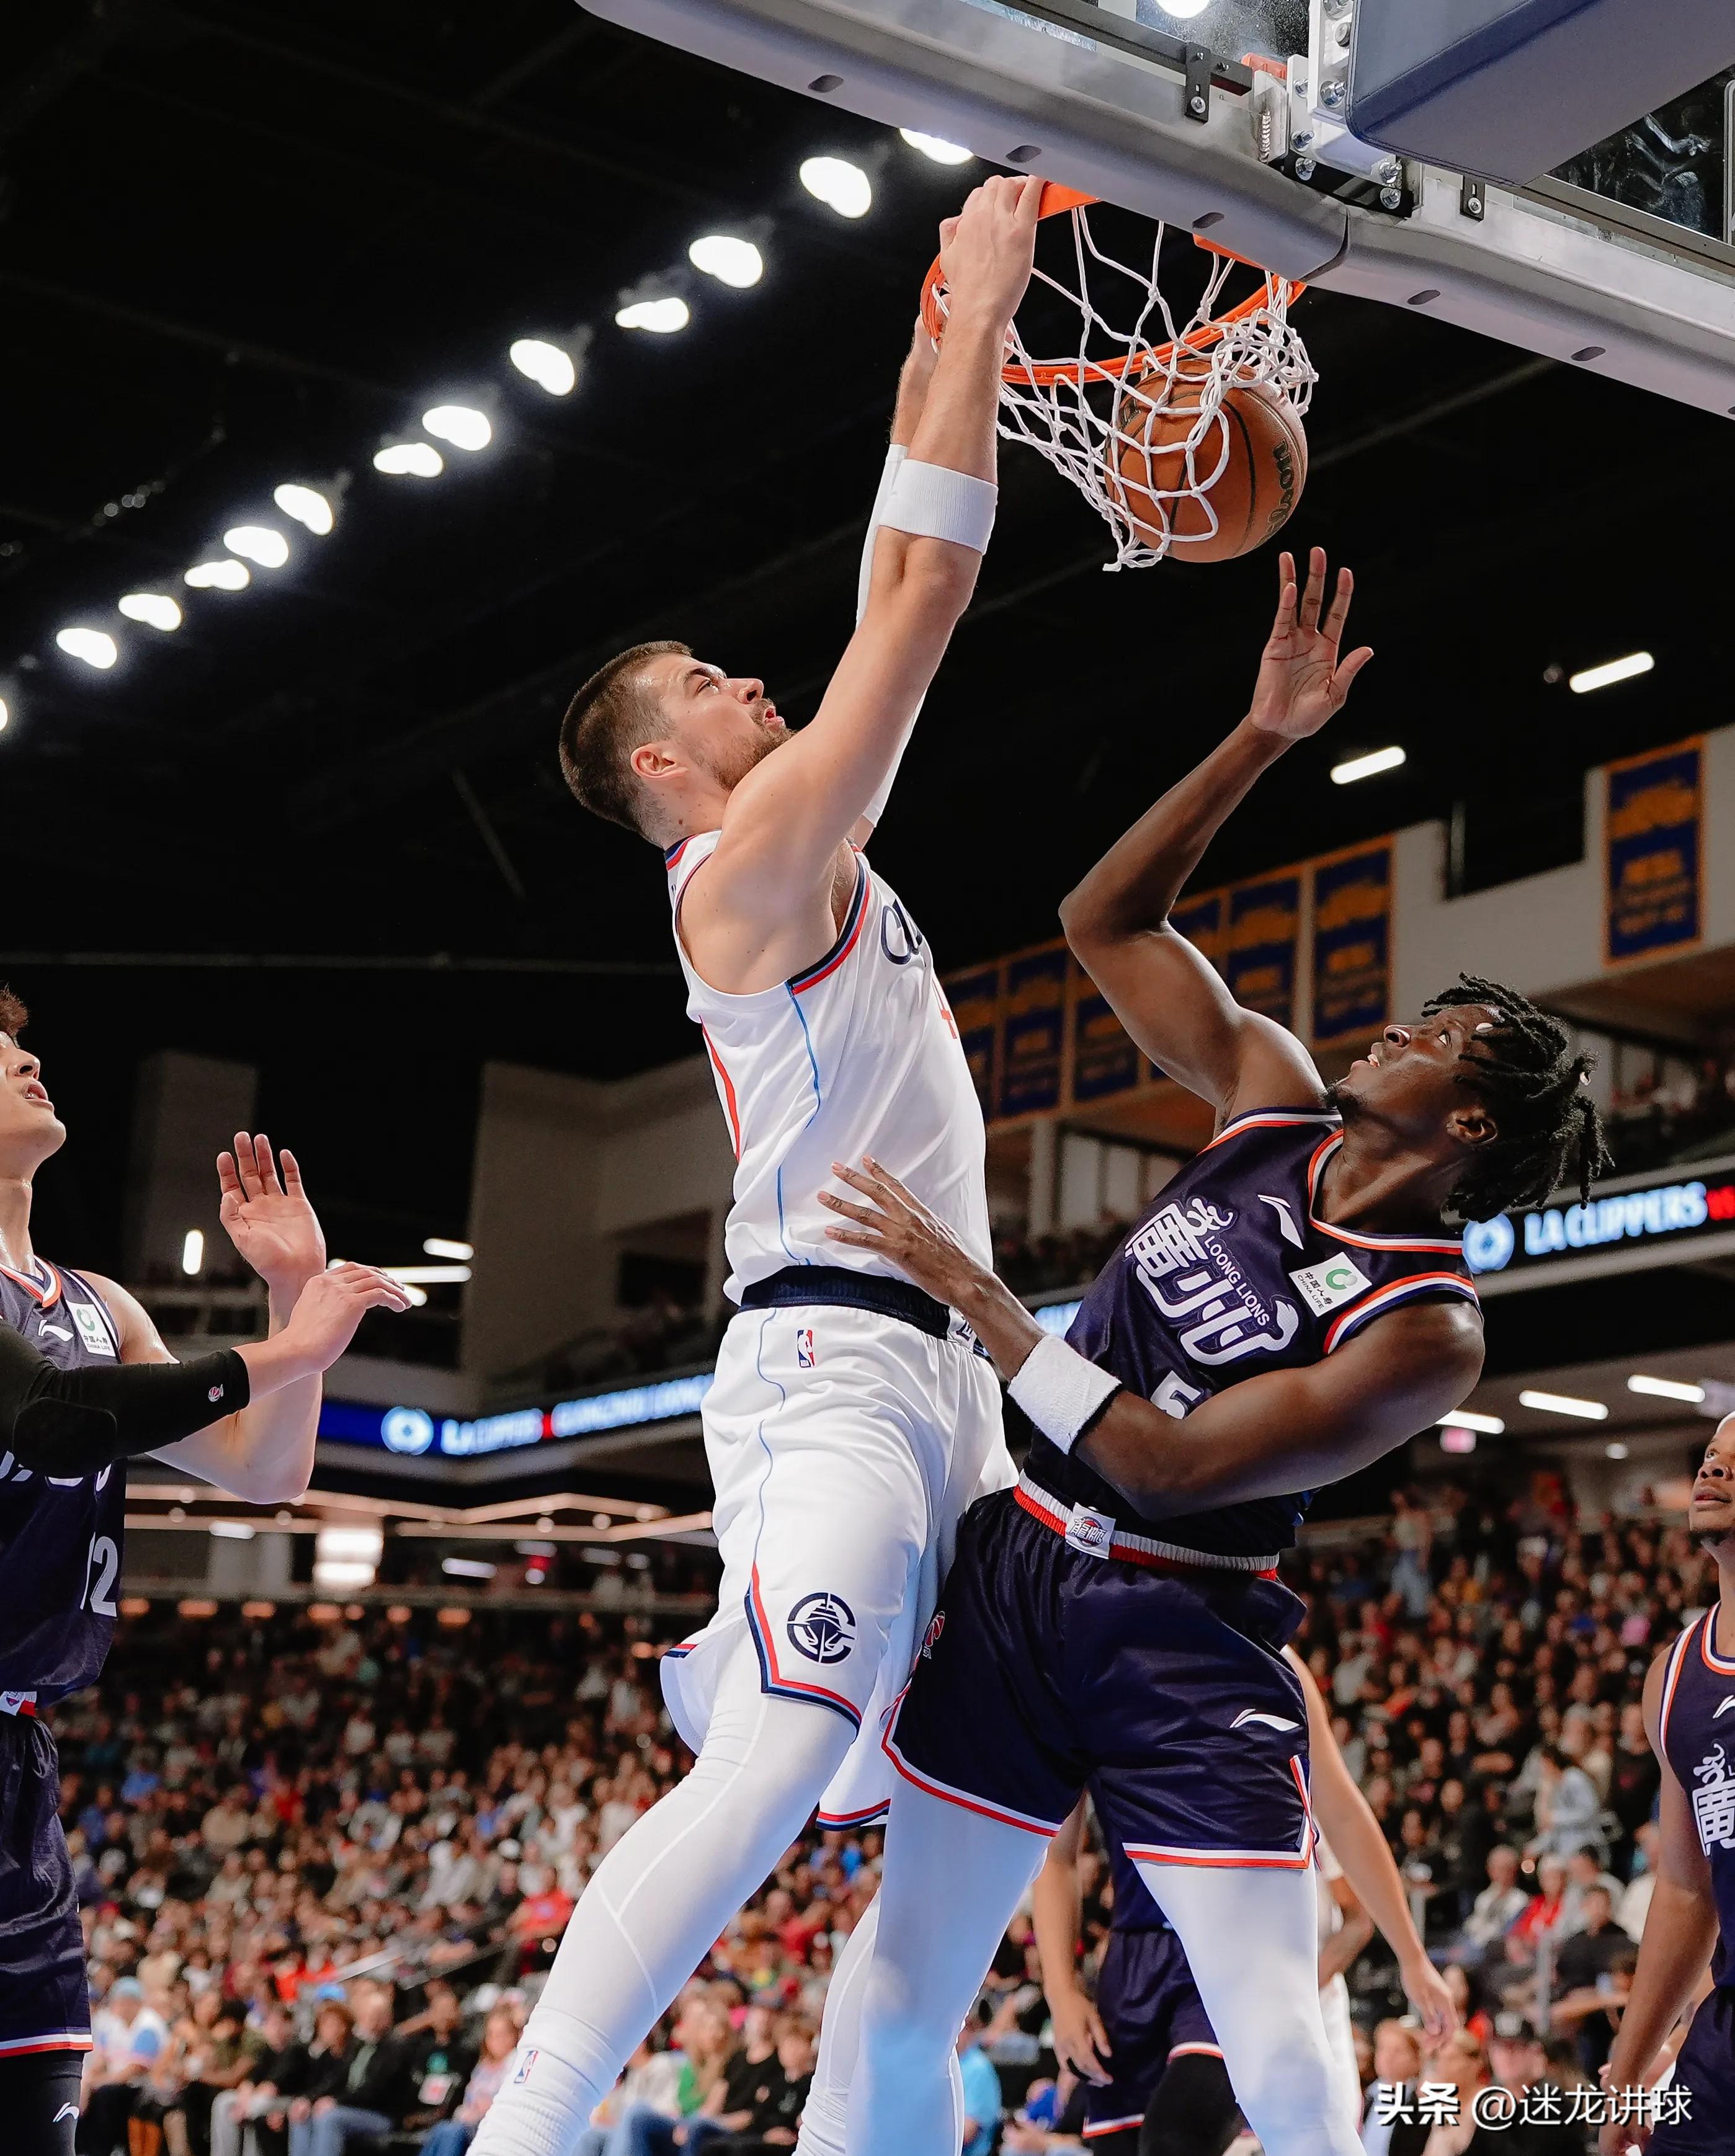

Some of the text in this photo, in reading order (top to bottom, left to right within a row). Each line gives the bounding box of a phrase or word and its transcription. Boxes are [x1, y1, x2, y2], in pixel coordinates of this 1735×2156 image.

[1204, 1236, 1270, 1326] LOONG LIONS
[1298, 1275, 1324, 1309] CHINA LIFE
